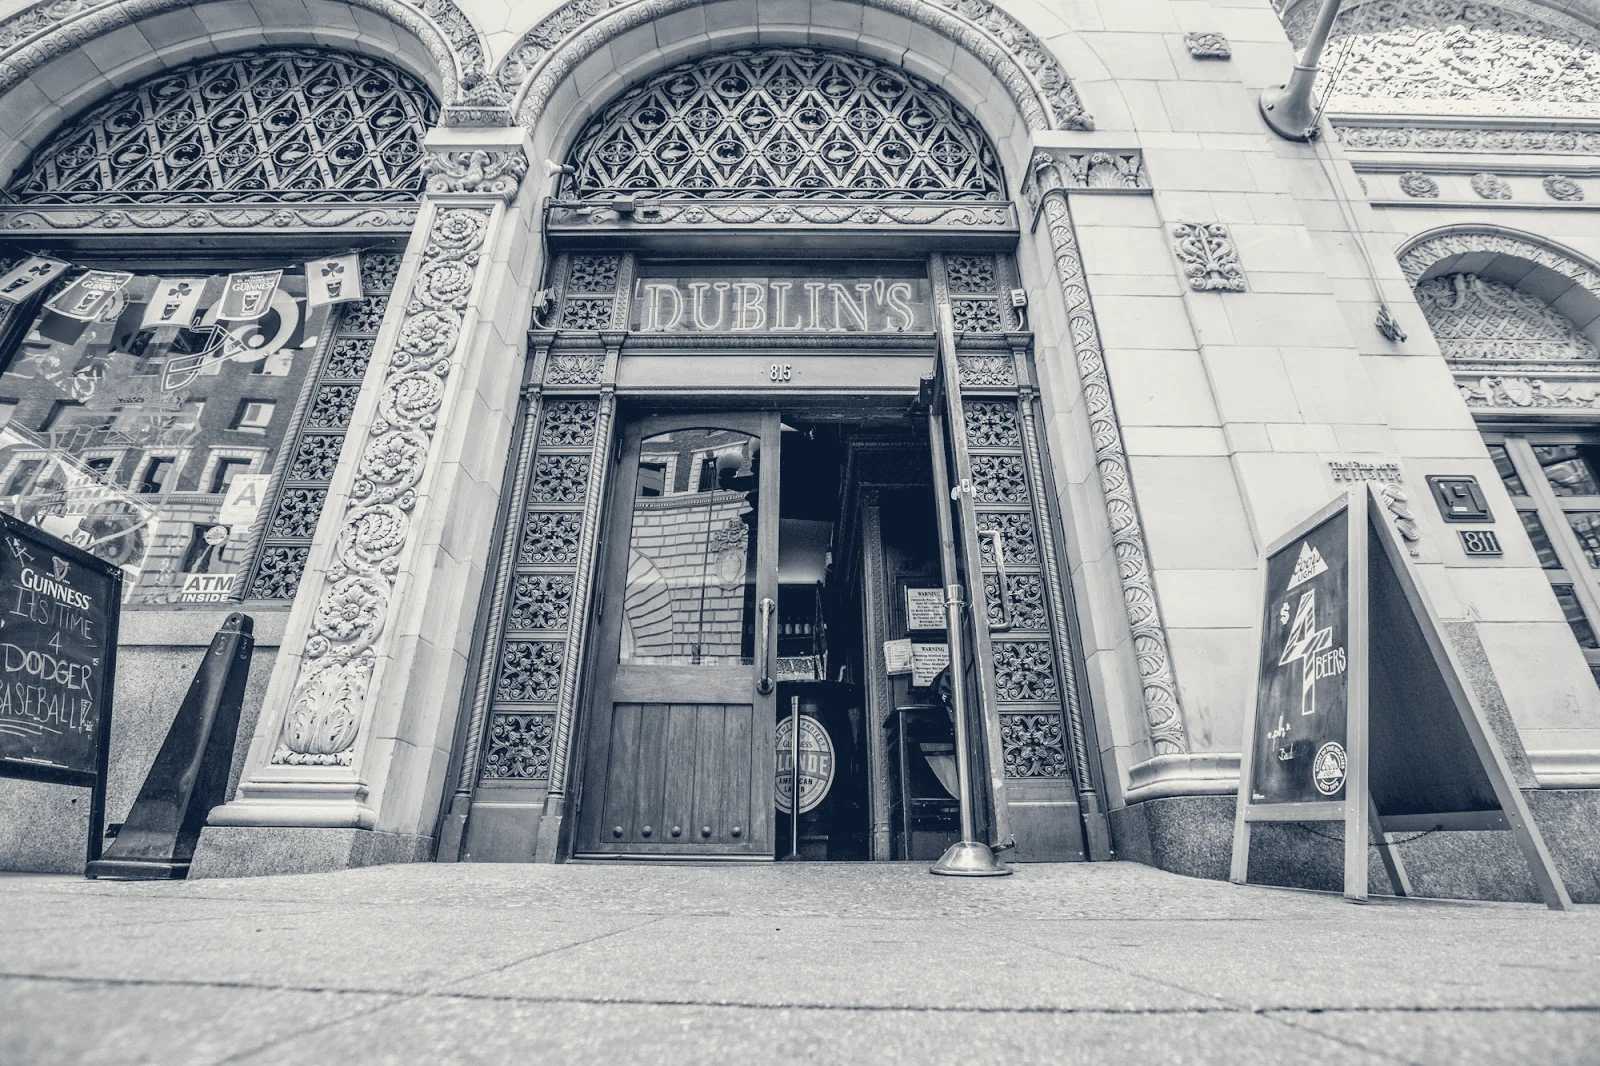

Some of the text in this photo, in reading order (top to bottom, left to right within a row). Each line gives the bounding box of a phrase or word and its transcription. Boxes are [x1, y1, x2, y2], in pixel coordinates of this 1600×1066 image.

[231, 282, 275, 291] GUINNESS
[641, 279, 914, 332] DUBLIN'S
[770, 364, 792, 382] 815
[232, 482, 257, 506] A
[1465, 532, 1499, 552] 811
[184, 576, 236, 590] ATM
[1298, 564, 1316, 582] LIGHT
[21, 567, 91, 610] GUINNESS
[181, 593, 231, 603] INSIDE
[48, 630, 63, 655] 4
[0, 643, 93, 700] DODGER
[1315, 646, 1347, 680] BEERS
[801, 721, 826, 747] PROJECT
[777, 754, 829, 777] LONDE
